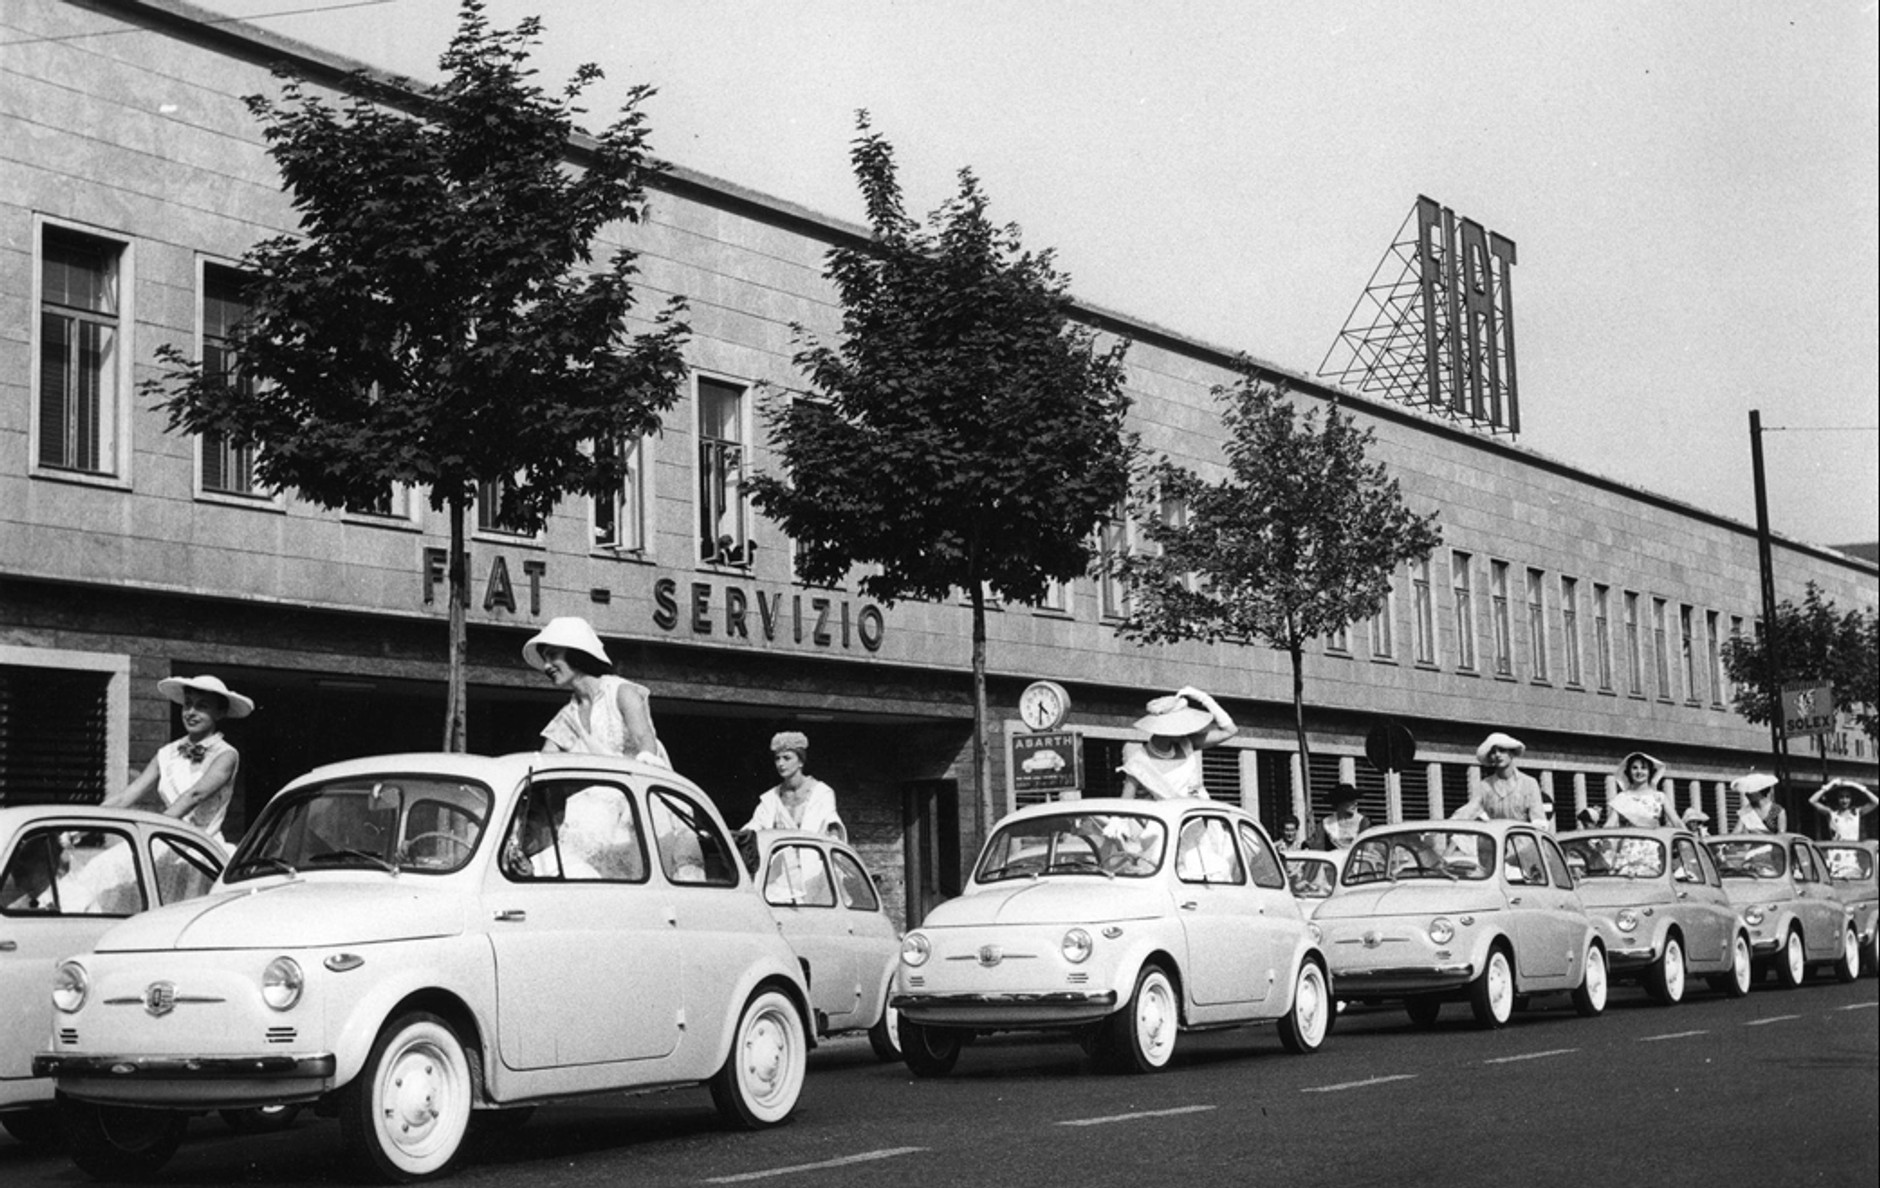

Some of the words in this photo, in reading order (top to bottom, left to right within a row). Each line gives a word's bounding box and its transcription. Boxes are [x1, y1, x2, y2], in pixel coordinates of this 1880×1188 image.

[1417, 193, 1520, 434] FIAT
[423, 546, 546, 616] FIAT
[652, 577, 885, 653] SERVIZIO
[1015, 735, 1073, 749] ABARTH
[1786, 715, 1830, 731] SOLEX
